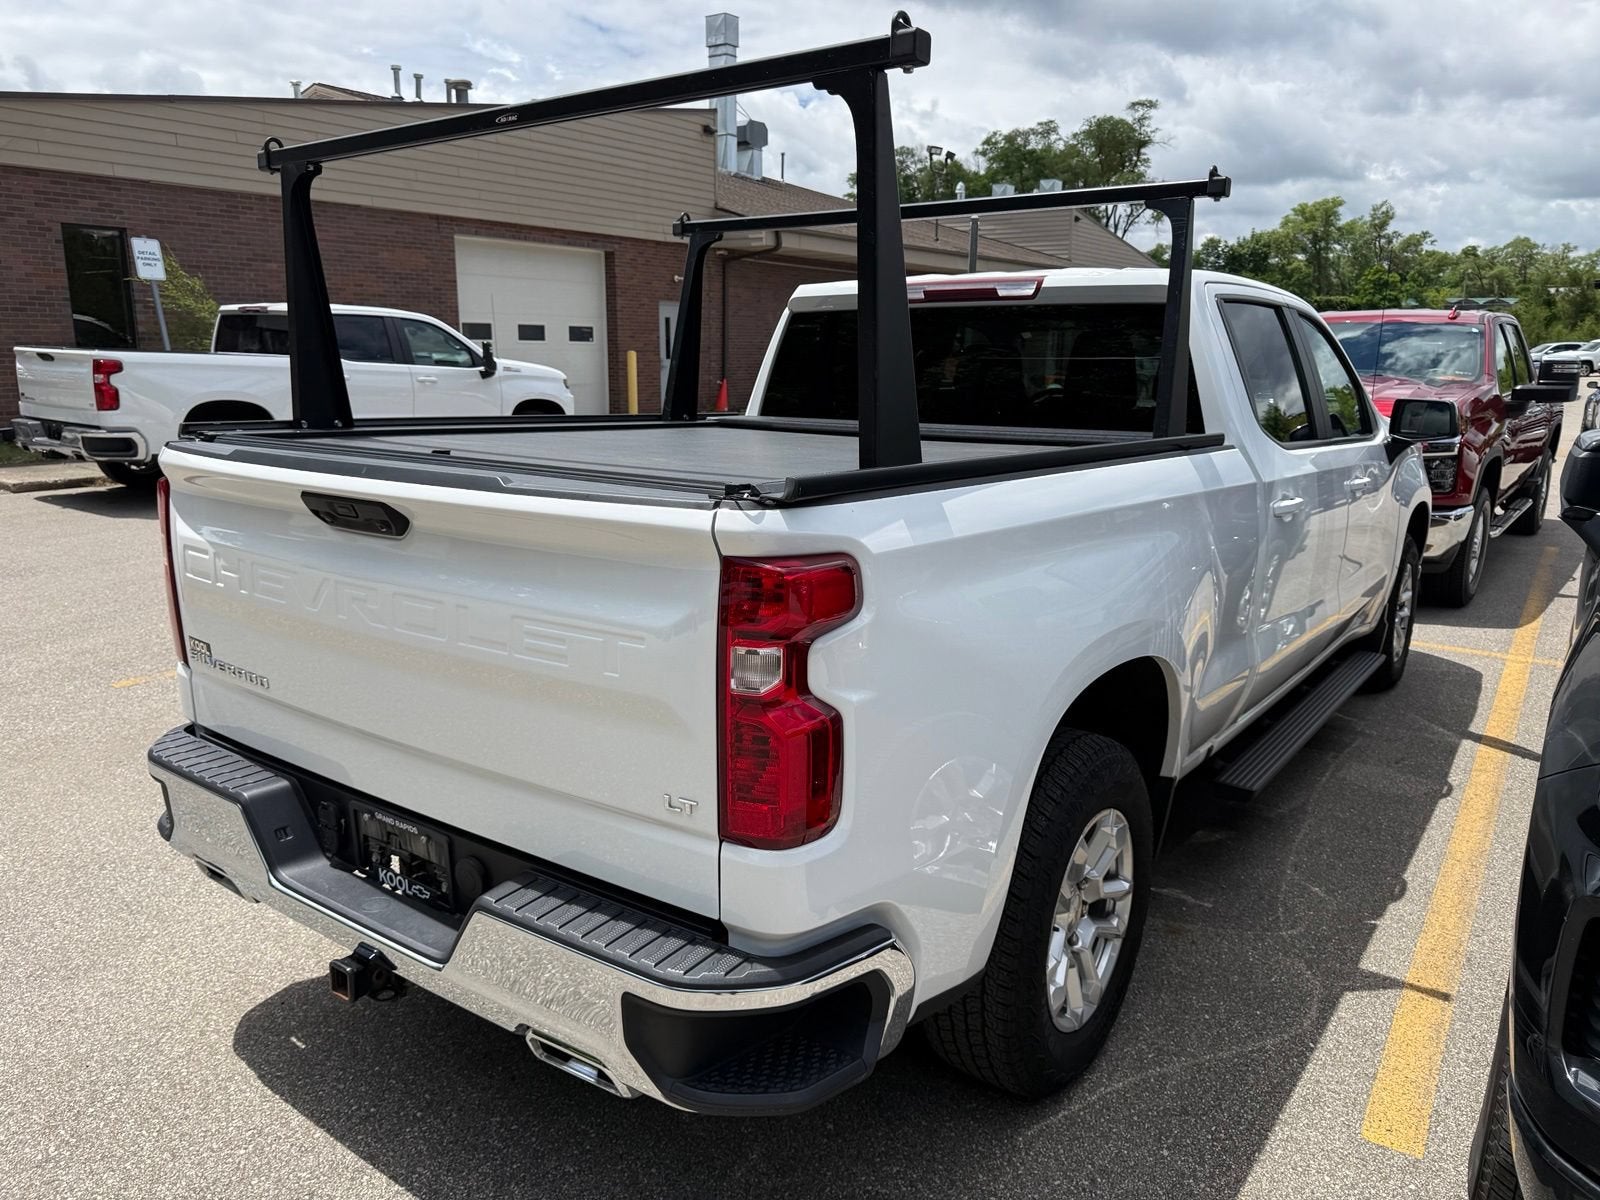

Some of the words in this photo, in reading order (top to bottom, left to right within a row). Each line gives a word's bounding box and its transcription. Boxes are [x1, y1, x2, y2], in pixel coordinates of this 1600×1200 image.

[183, 543, 647, 678] CHEVROLET
[190, 649, 270, 689] SILVERADO
[663, 793, 698, 815] LT
[374, 811, 395, 826] GRAND
[395, 820, 419, 835] RAPIDS
[378, 867, 413, 894] KOOL
